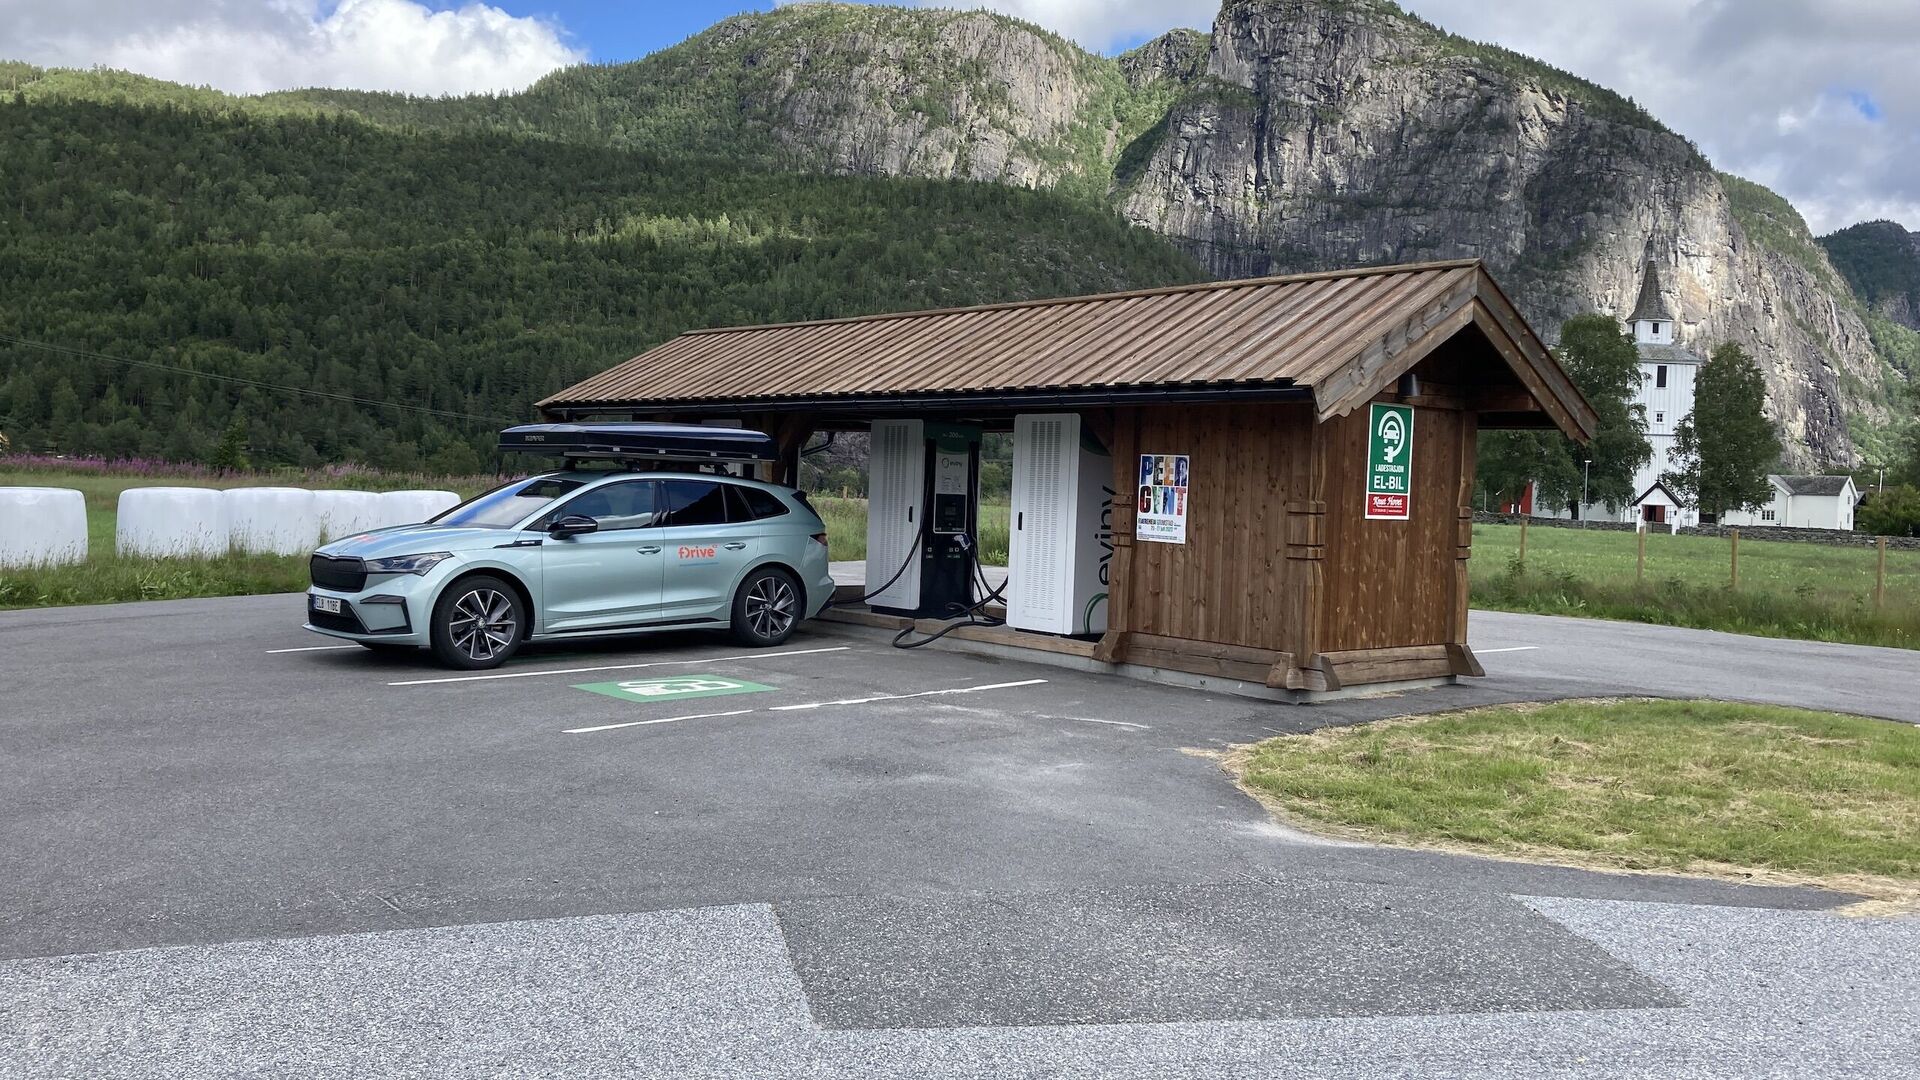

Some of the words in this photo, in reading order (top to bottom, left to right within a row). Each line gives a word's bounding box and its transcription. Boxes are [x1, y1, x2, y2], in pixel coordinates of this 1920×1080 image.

[1141, 455, 1188, 486] PEER
[1374, 475, 1404, 490] EL-BIL
[1375, 464, 1405, 473] LADESTASJON
[1140, 485, 1187, 516] GYNT
[1095, 485, 1116, 586] eviny
